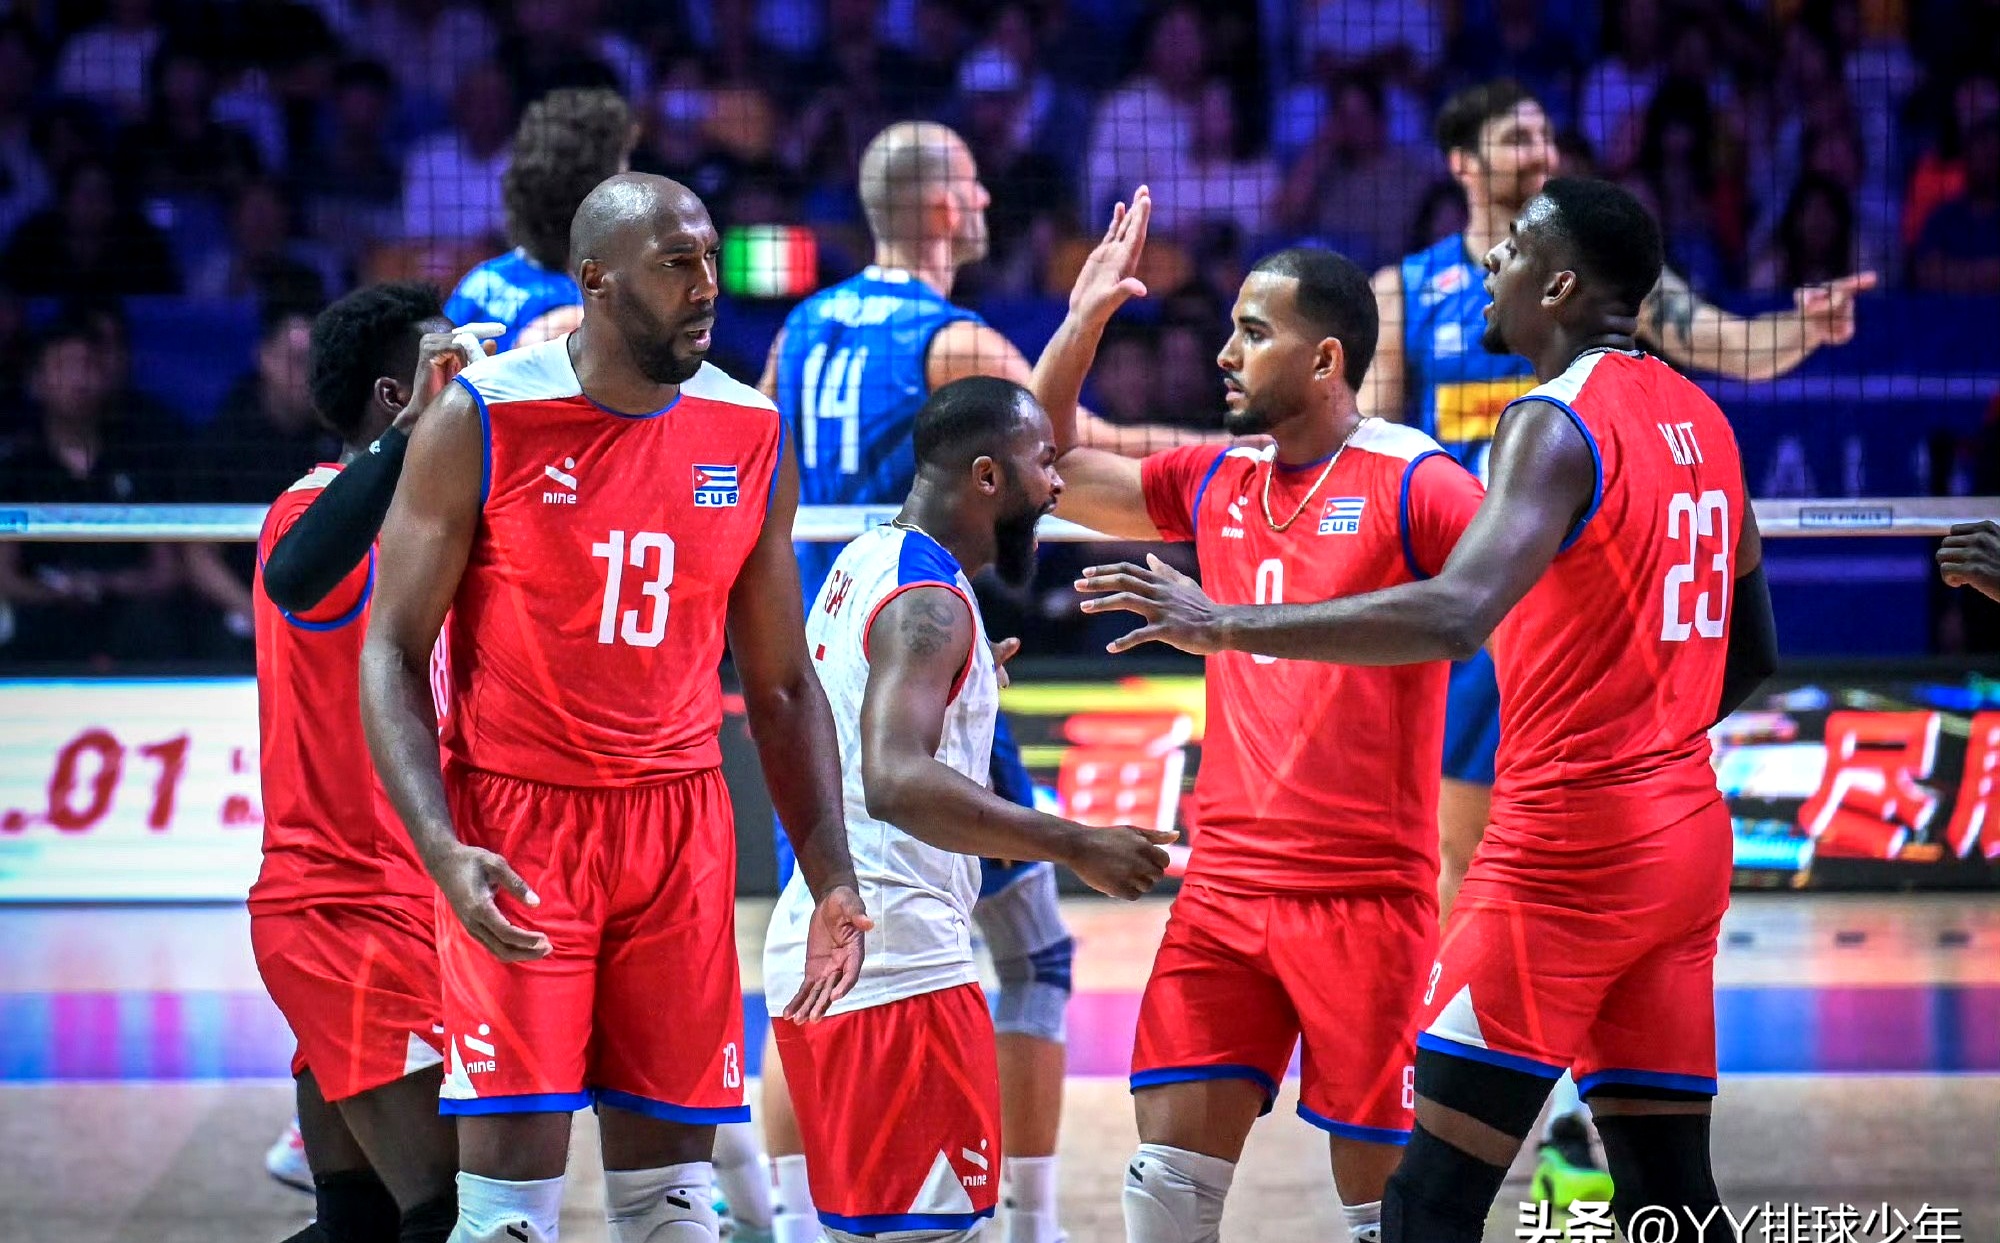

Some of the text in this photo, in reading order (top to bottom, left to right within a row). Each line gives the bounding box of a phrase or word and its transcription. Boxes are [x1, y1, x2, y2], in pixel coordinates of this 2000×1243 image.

[803, 342, 868, 474] 14
[543, 492, 577, 504] nine
[695, 492, 737, 505] CUB
[1319, 521, 1358, 532] CUB
[1660, 490, 1729, 641] 23
[592, 530, 675, 647] 13
[1424, 959, 1443, 1006] 3
[466, 1060, 496, 1073] nine
[723, 1042, 741, 1088] 13
[962, 1174, 987, 1187] nine
